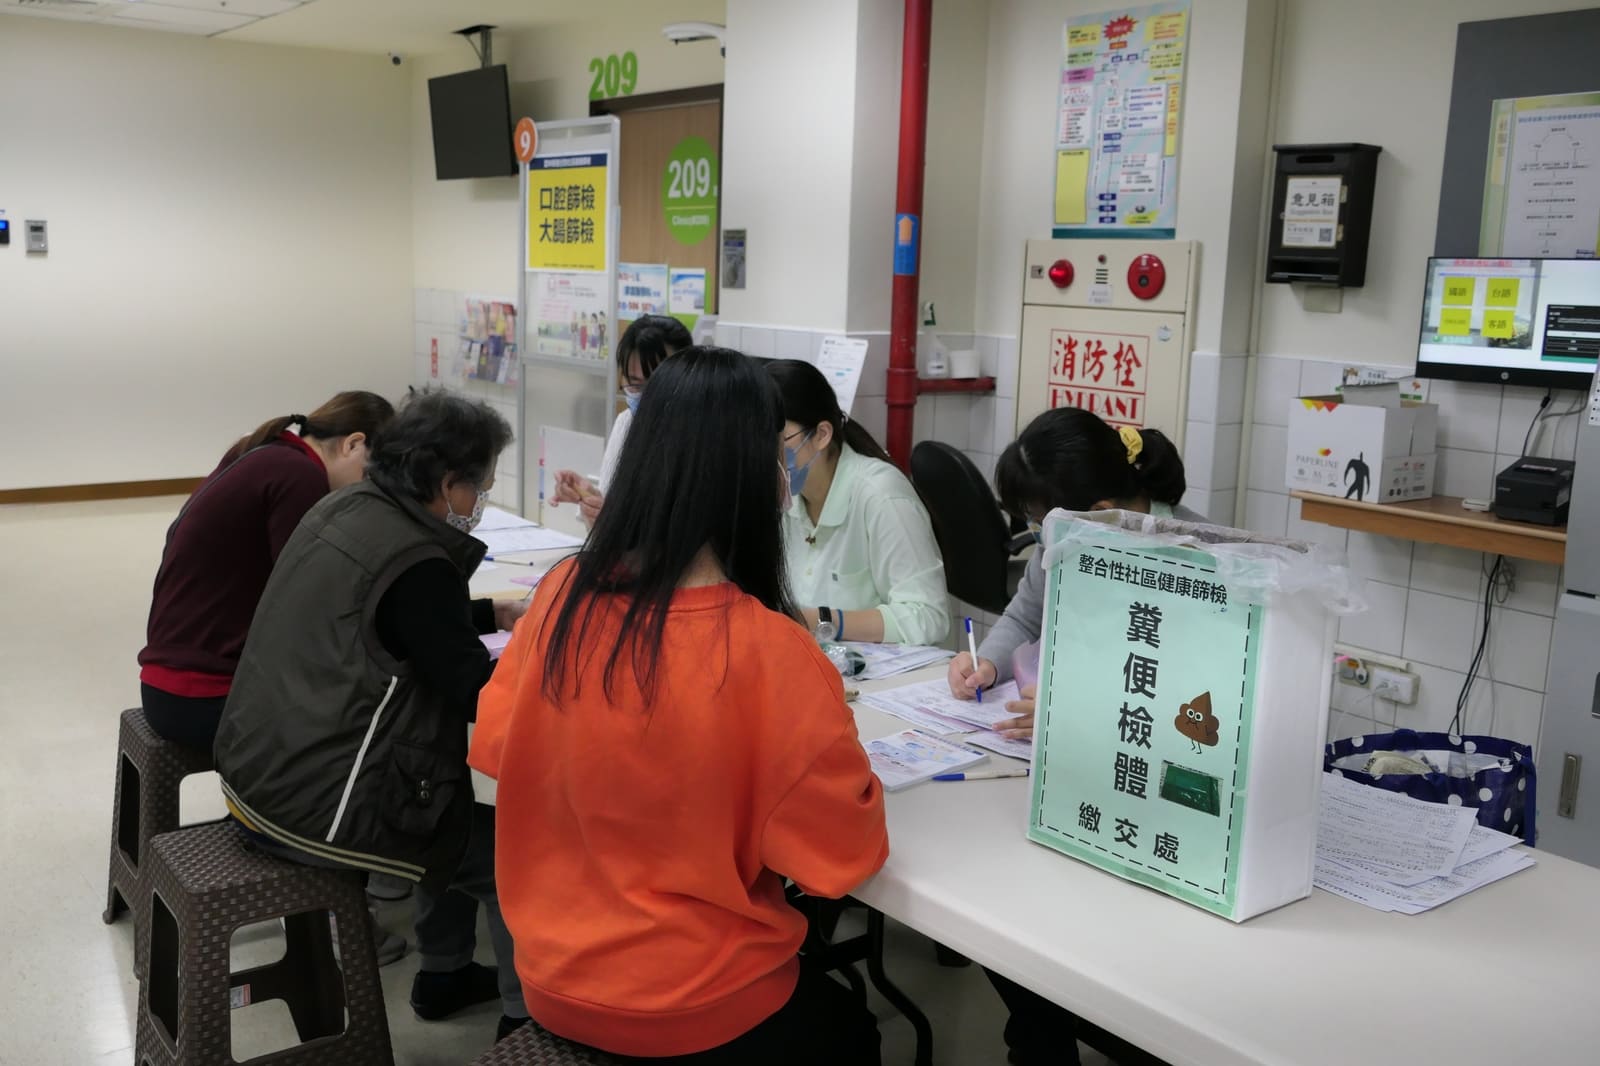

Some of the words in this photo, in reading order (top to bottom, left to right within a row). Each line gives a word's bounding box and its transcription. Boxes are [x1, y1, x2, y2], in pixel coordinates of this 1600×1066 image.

[588, 51, 638, 101] 209
[520, 131, 531, 157] 9
[539, 184, 595, 212] 口腔篩檢
[1291, 193, 1335, 207] 意見箱
[539, 217, 594, 244] 大腸篩檢
[1053, 334, 1142, 387] 消防栓
[1296, 455, 1339, 469] PAPERLINE
[1078, 553, 1228, 605] 整合性社區健康篩檢
[1113, 601, 1163, 800] 糞便檢體
[1078, 801, 1179, 865] 繳交處
